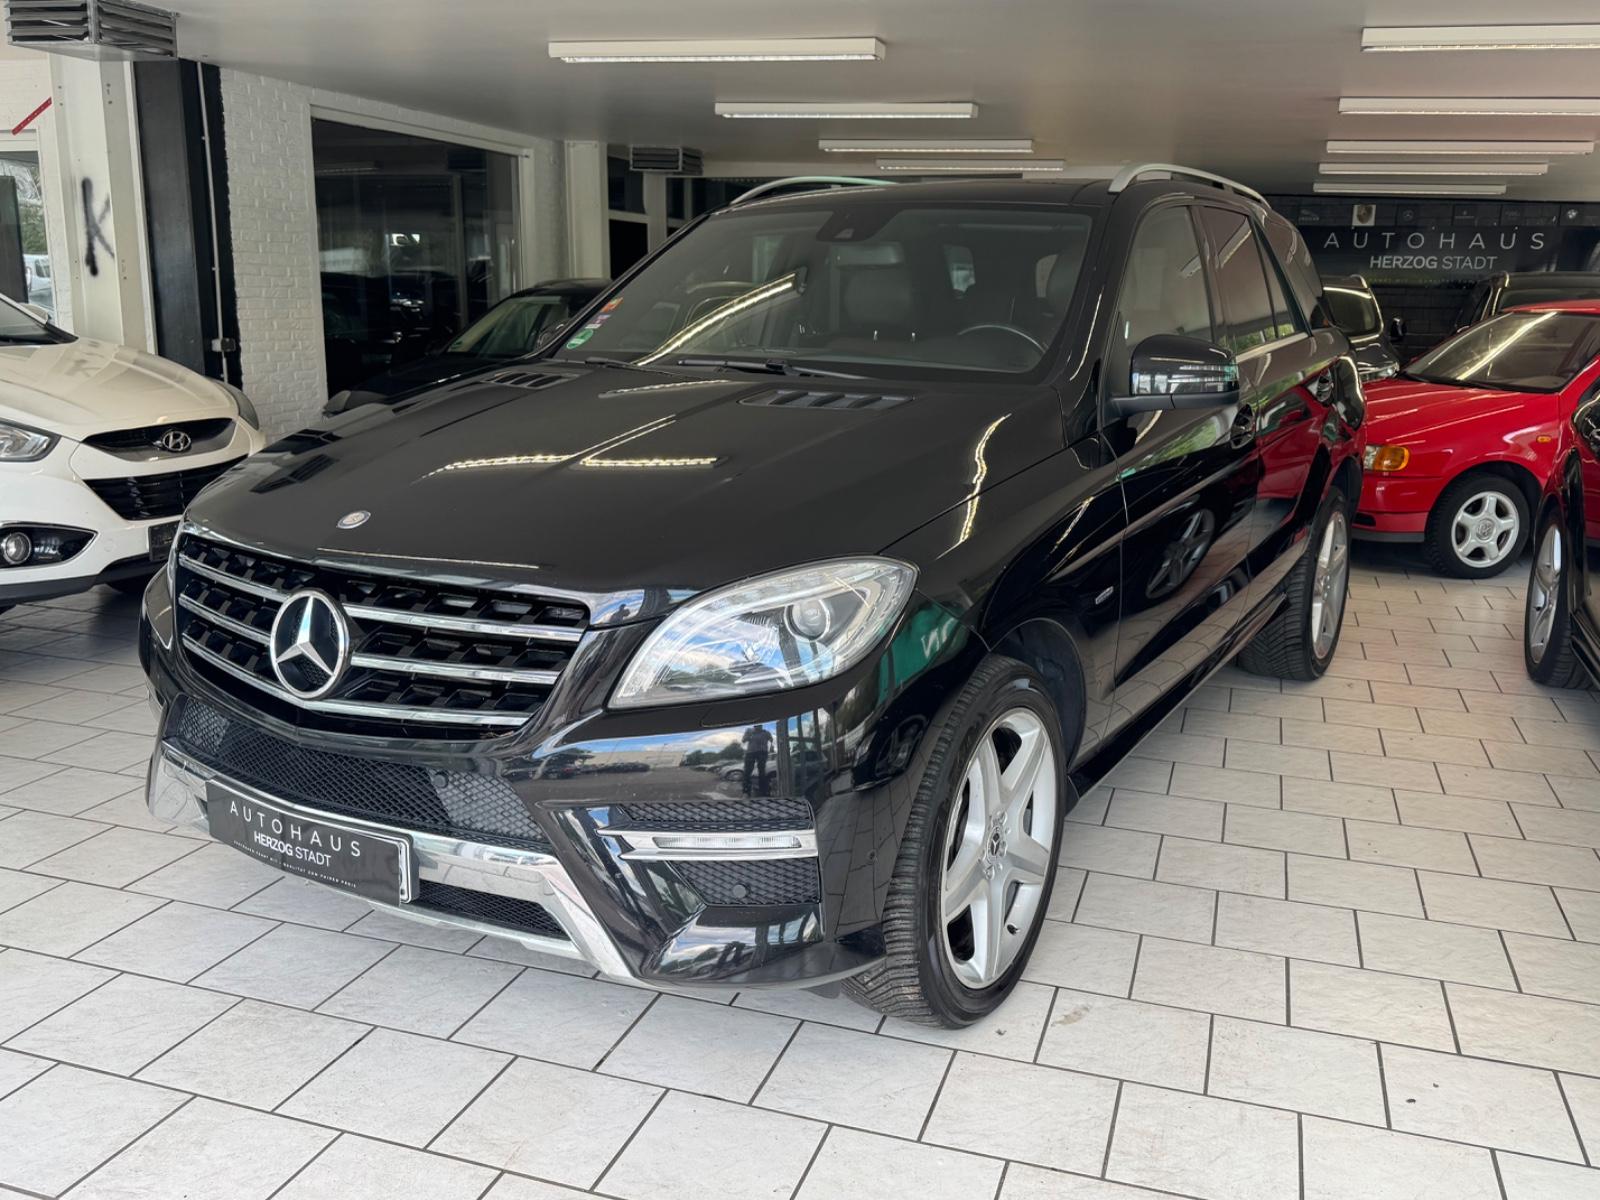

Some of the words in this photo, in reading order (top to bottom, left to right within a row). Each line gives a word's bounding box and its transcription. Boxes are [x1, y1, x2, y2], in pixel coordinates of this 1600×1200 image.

[1324, 232, 1545, 250] AUTOHAUS
[1369, 255, 1438, 270] HERZOG
[1441, 256, 1498, 270] STADT
[230, 800, 361, 857] AUTOHAUS
[253, 830, 293, 857] HERZOG
[295, 847, 332, 867] STADT
